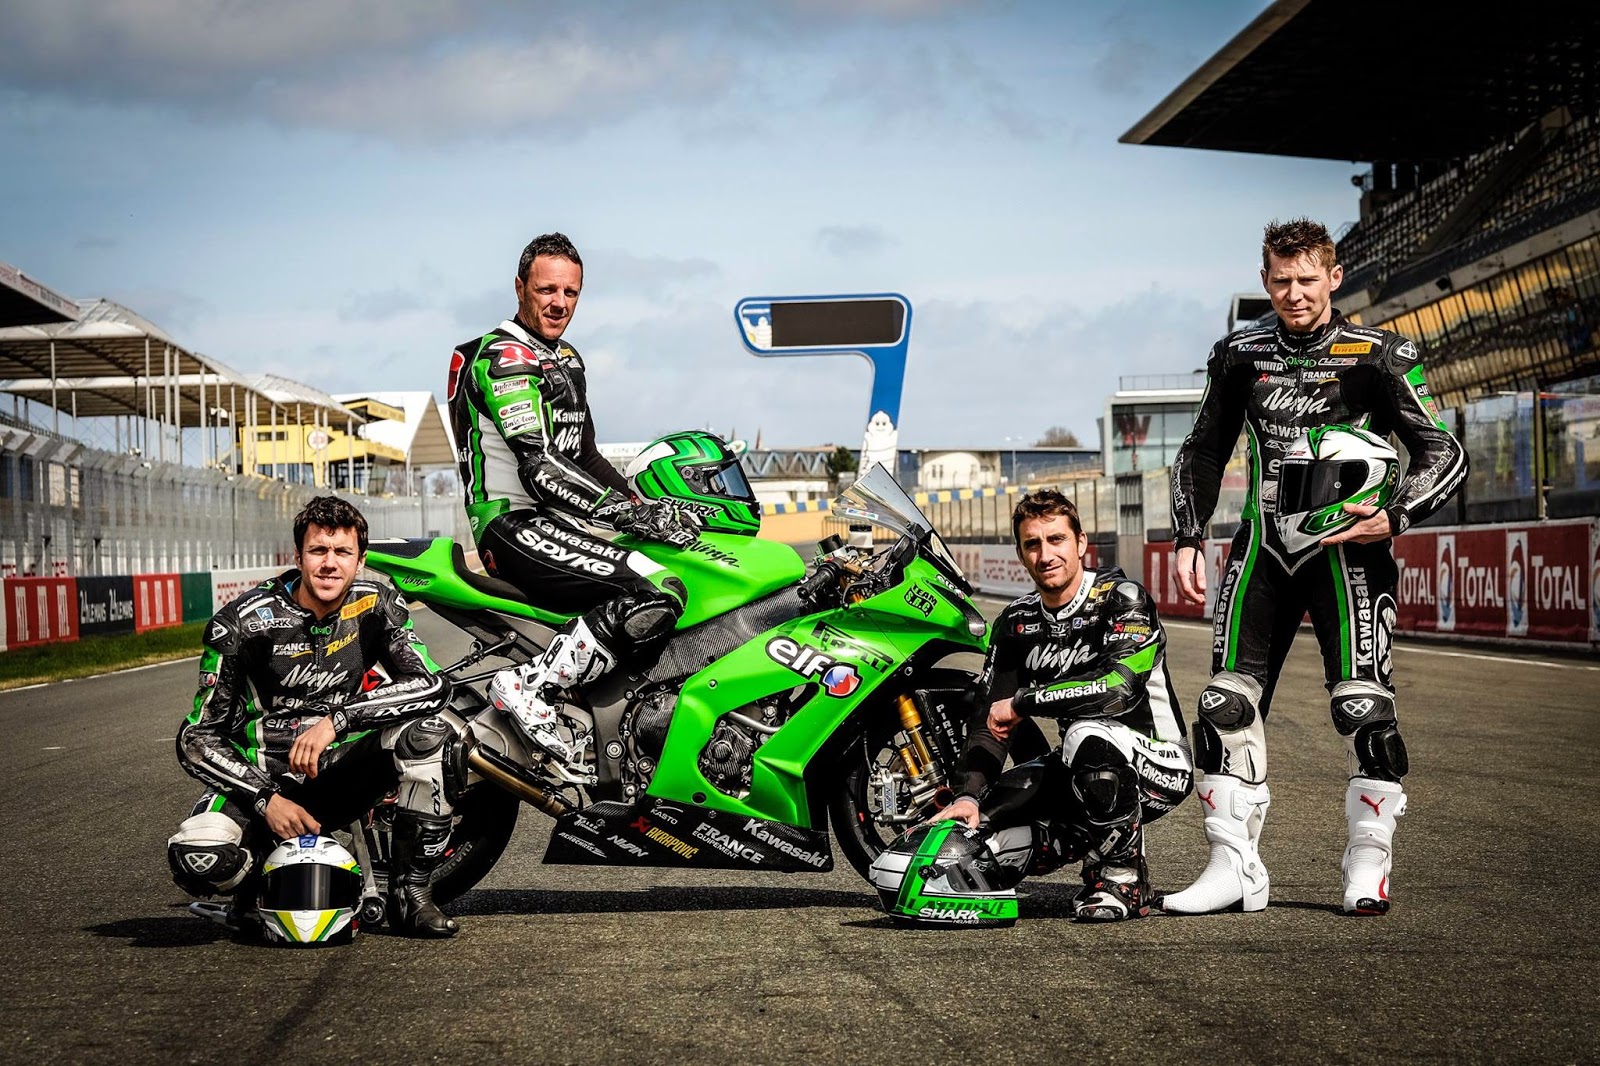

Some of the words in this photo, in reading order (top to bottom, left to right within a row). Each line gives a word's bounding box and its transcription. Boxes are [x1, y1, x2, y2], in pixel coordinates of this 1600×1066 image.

[1333, 343, 1369, 352] PIRELLI
[1303, 370, 1337, 379] FRANCE
[552, 408, 586, 423] Kawas
[1262, 386, 1331, 421] Ninja
[1258, 418, 1311, 439] Kawas
[534, 470, 600, 513] Kawasa
[657, 495, 721, 518] SHARK
[528, 517, 626, 561] Kawasaki
[690, 541, 740, 569] Ninja
[1396, 558, 1436, 606] TOTAL
[1457, 556, 1504, 608] TOTAL
[1531, 555, 1586, 611] TOTAL
[1213, 561, 1239, 655] Kawasaki
[1347, 567, 1373, 667] Kawasaki
[248, 617, 294, 633] SHARK
[1108, 633, 1130, 642] elf
[273, 642, 311, 653] FRANCE
[767, 638, 832, 677] elf
[811, 620, 894, 675] PIRLLI
[1025, 637, 1099, 679] Ninja
[280, 662, 349, 695] Ninja
[366, 675, 430, 698] Kawasaki
[1034, 680, 1107, 704] Kawasaki
[271, 693, 349, 709] Kawaki
[265, 718, 290, 730] elf
[936, 704, 961, 759] PIRELL
[1136, 752, 1190, 793] Kawasaki
[650, 808, 679, 826] KASTO
[286, 850, 327, 858] SHARK
[692, 830, 740, 861] EQUIPEMENT
[695, 822, 765, 865] FRANCE
[742, 818, 830, 868] Kawasaki
[918, 907, 984, 920] SHARK
